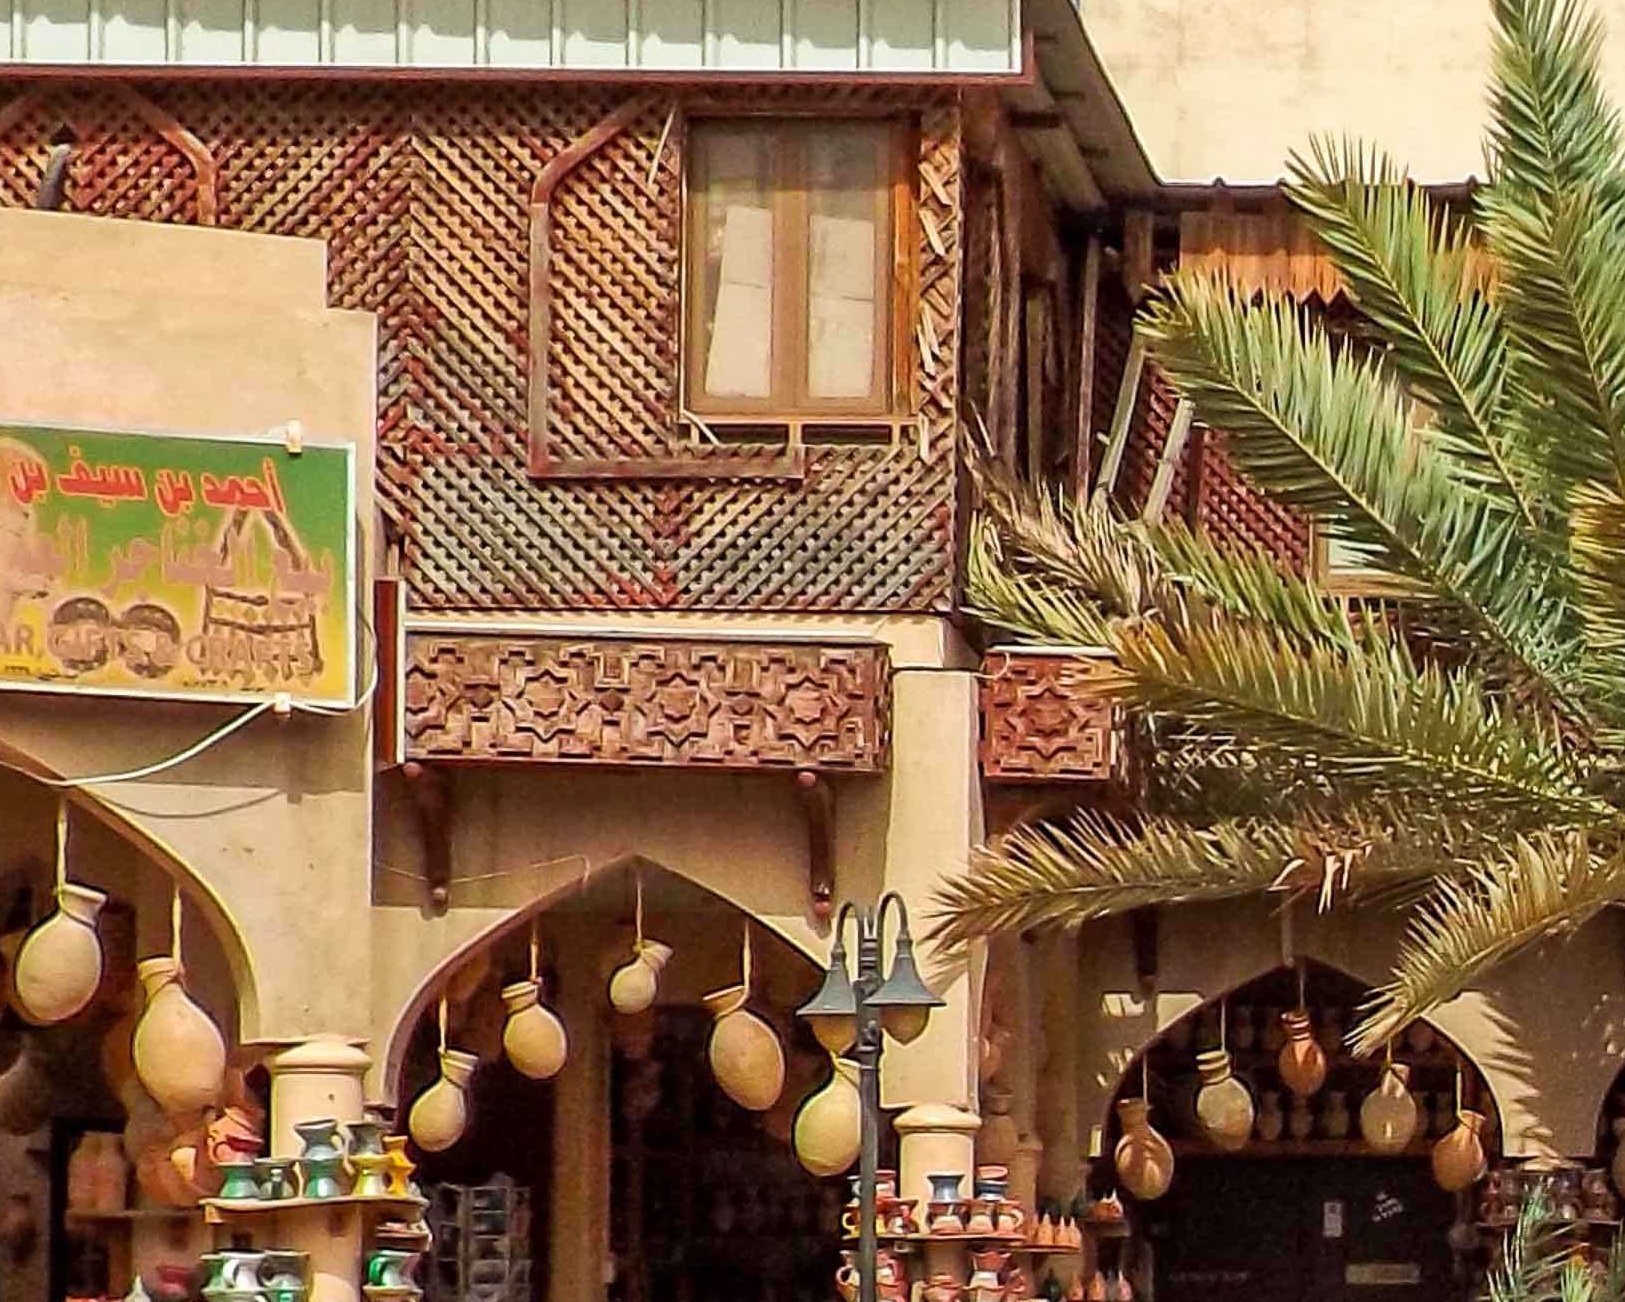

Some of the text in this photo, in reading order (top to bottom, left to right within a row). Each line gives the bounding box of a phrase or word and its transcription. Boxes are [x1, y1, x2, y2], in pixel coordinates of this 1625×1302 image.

[7, 450, 47, 507] بن
[55, 445, 147, 507] سيف
[155, 469, 195, 516] بن
[200, 458, 286, 514] أحمد
